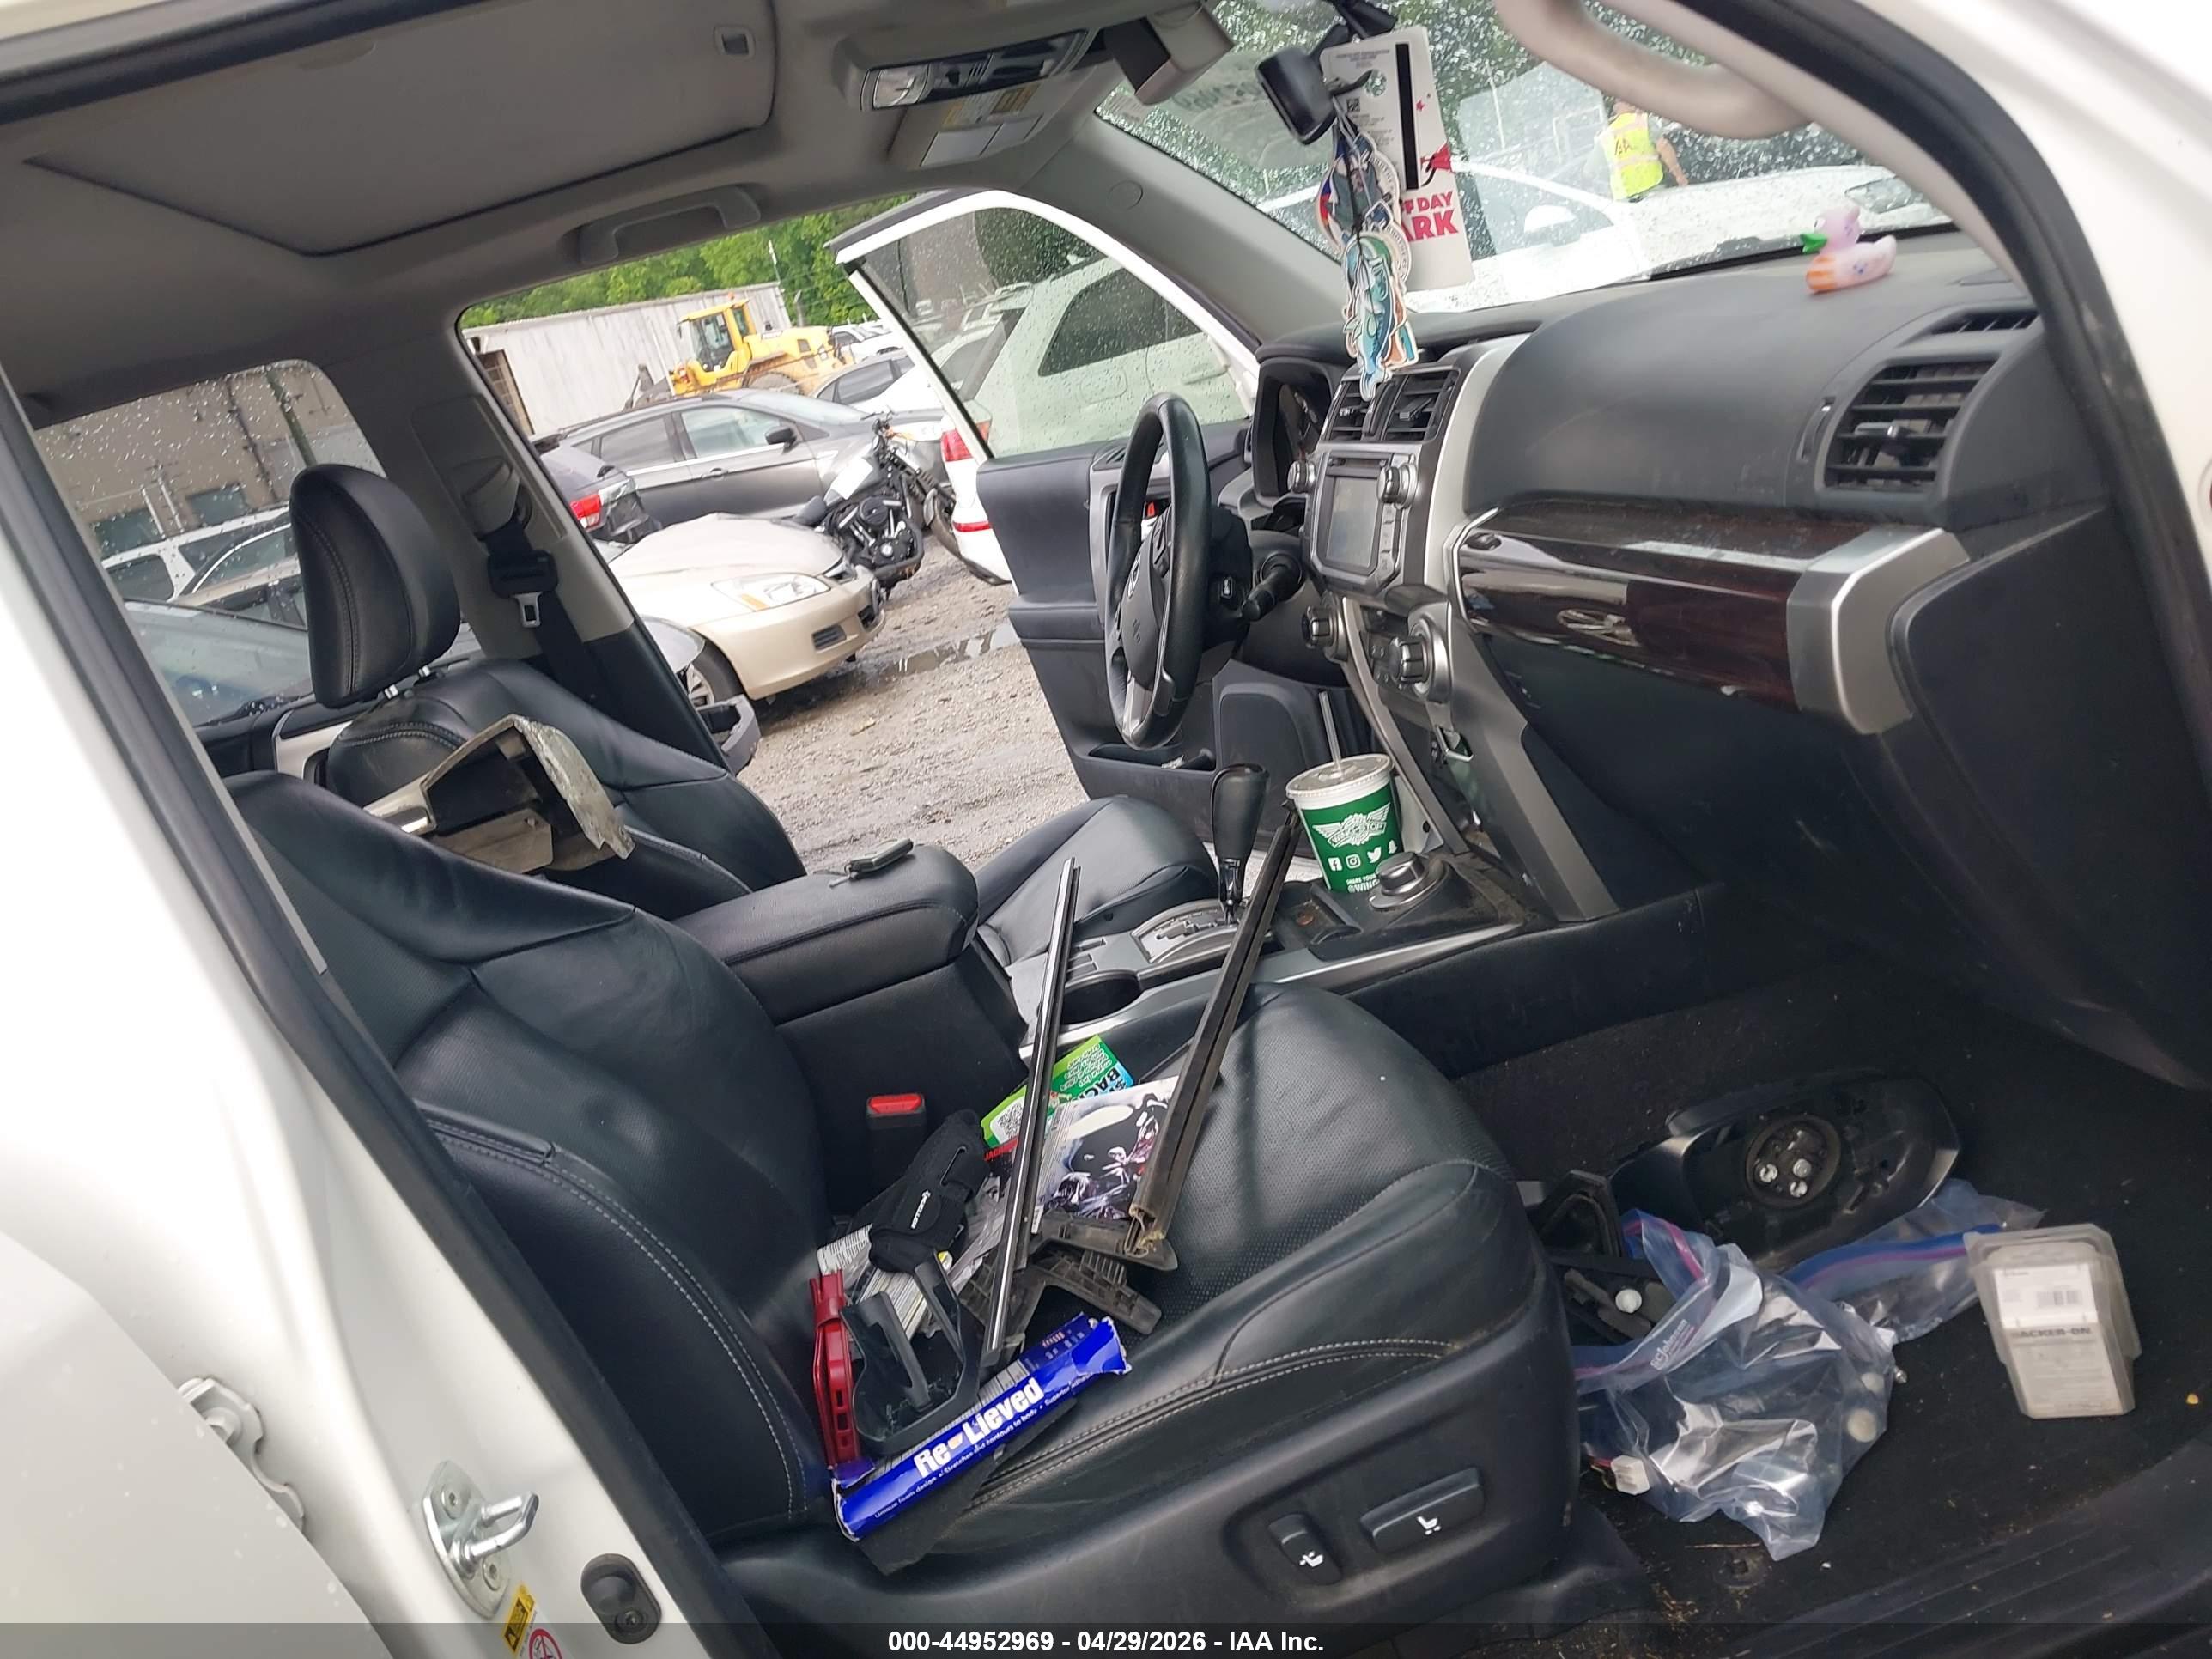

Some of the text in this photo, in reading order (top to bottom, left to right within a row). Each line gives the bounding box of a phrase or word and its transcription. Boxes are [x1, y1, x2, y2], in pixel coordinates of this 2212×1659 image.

[1417, 191, 1453, 211] DAY
[913, 1377, 1045, 1479] Re-Lieved
[915, 1476, 937, 1495] design
[943, 1451, 975, 1474] Stretches
[986, 1424, 1014, 1446] contours
[1013, 1418, 1022, 1428] to
[1021, 1408, 1038, 1424] body
